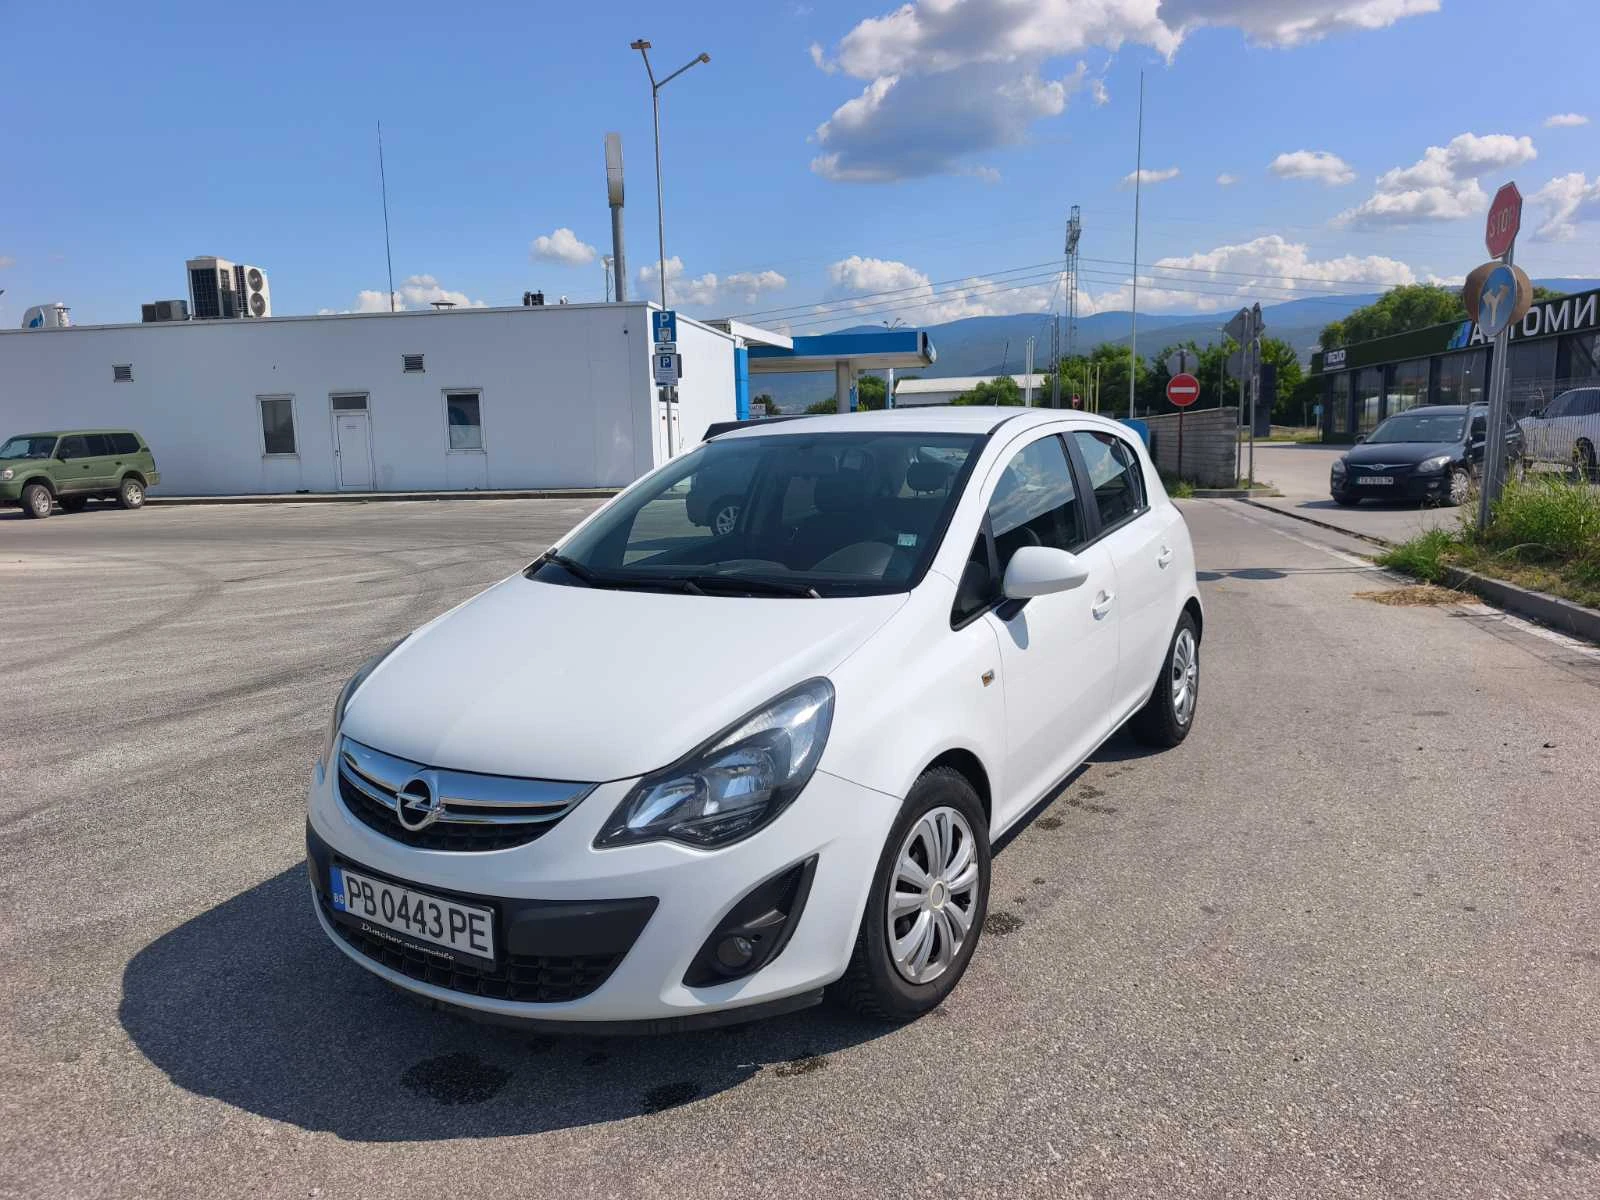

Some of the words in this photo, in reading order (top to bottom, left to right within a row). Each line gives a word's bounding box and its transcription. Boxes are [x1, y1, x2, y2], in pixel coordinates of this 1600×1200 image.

[660, 312, 670, 327] P
[1470, 294, 1598, 346] АОМИ
[346, 875, 377, 916] PB
[381, 889, 444, 938] 0443
[449, 907, 489, 952] PE
